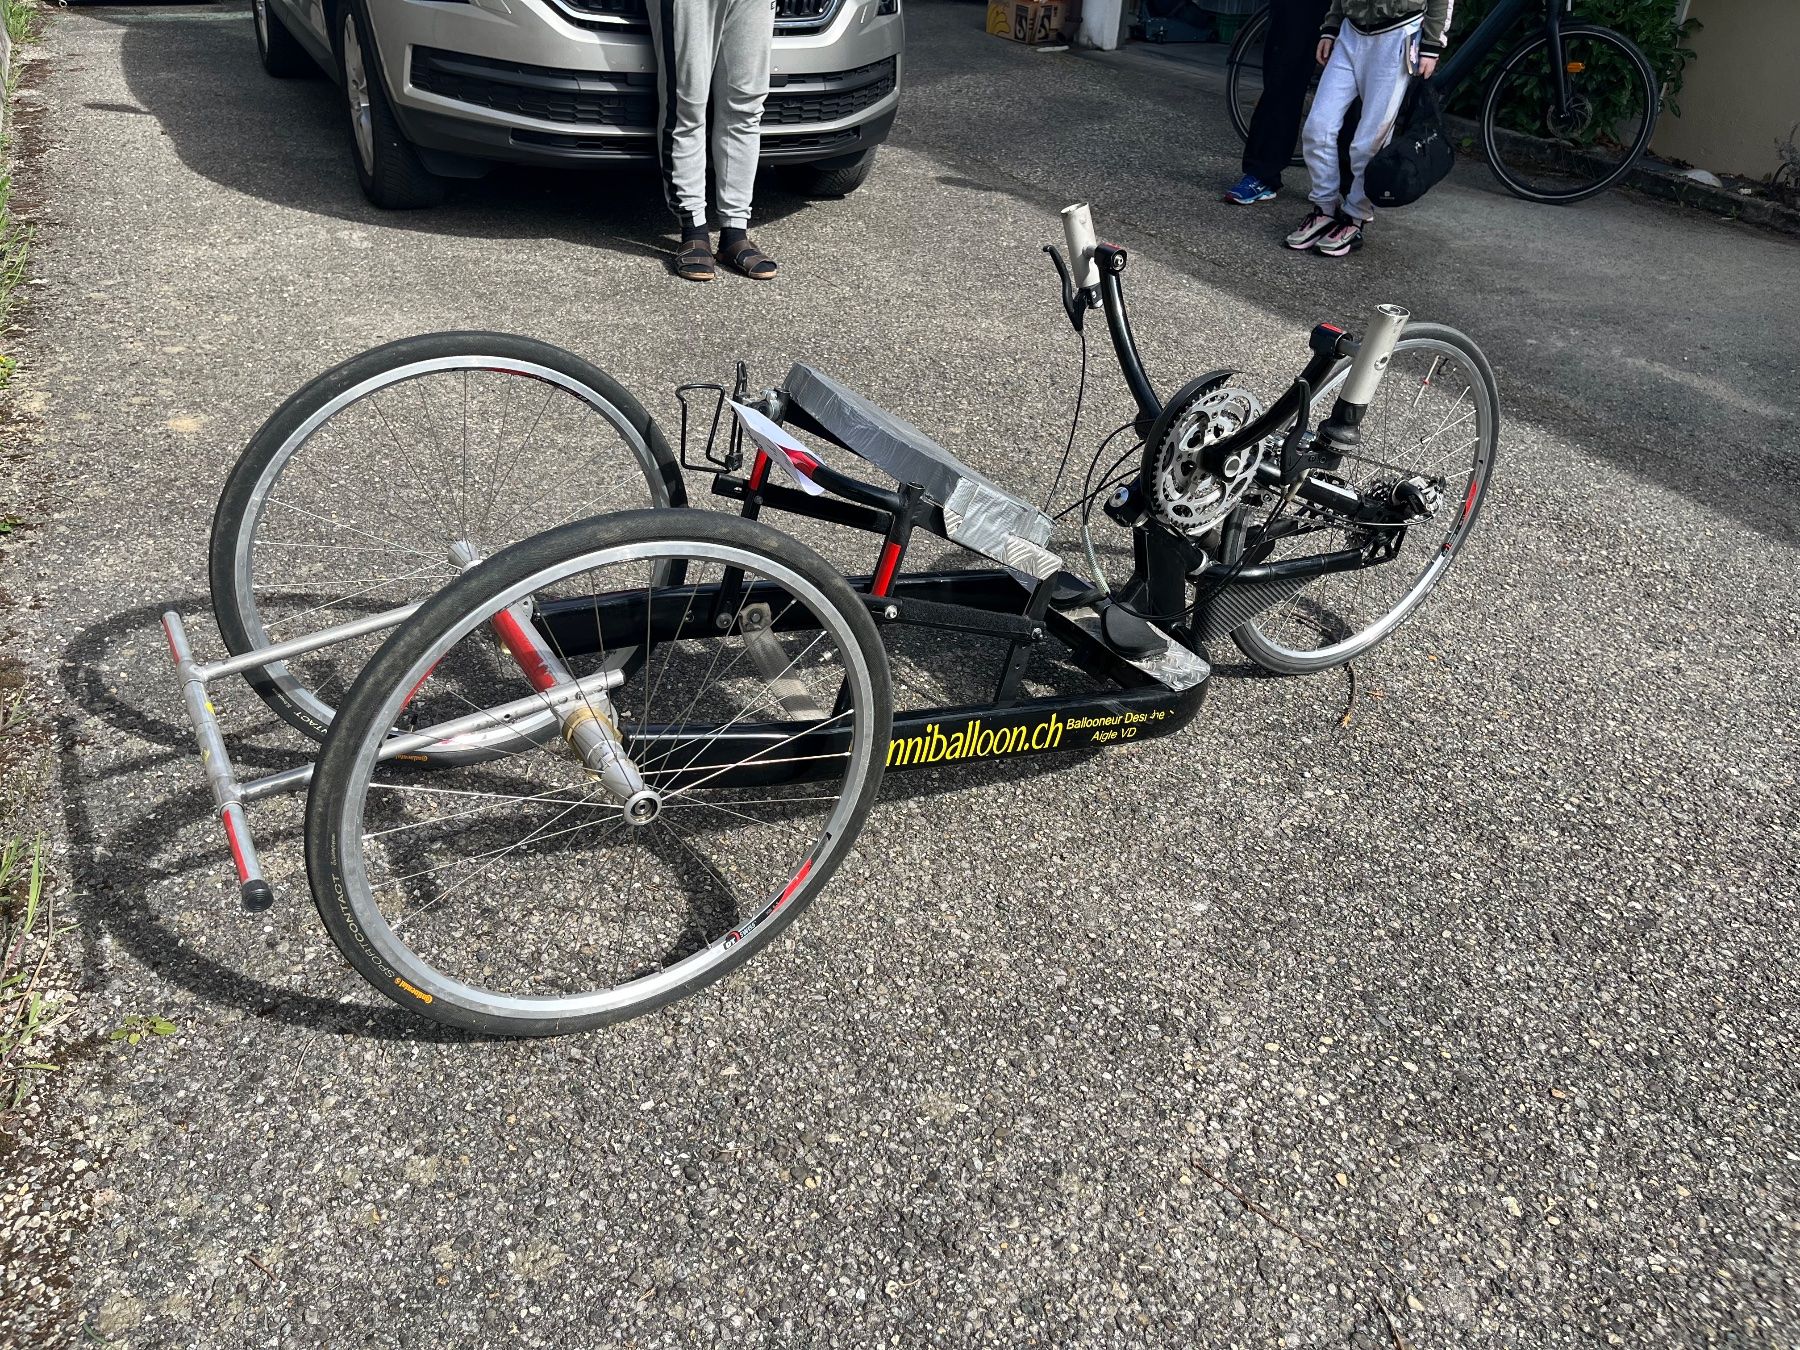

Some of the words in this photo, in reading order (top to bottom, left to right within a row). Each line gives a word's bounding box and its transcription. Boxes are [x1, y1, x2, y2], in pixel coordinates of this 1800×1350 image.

[1066, 715, 1123, 730] Ballooneur
[1090, 730, 1118, 743] Aigle
[1120, 727, 1137, 738] VD
